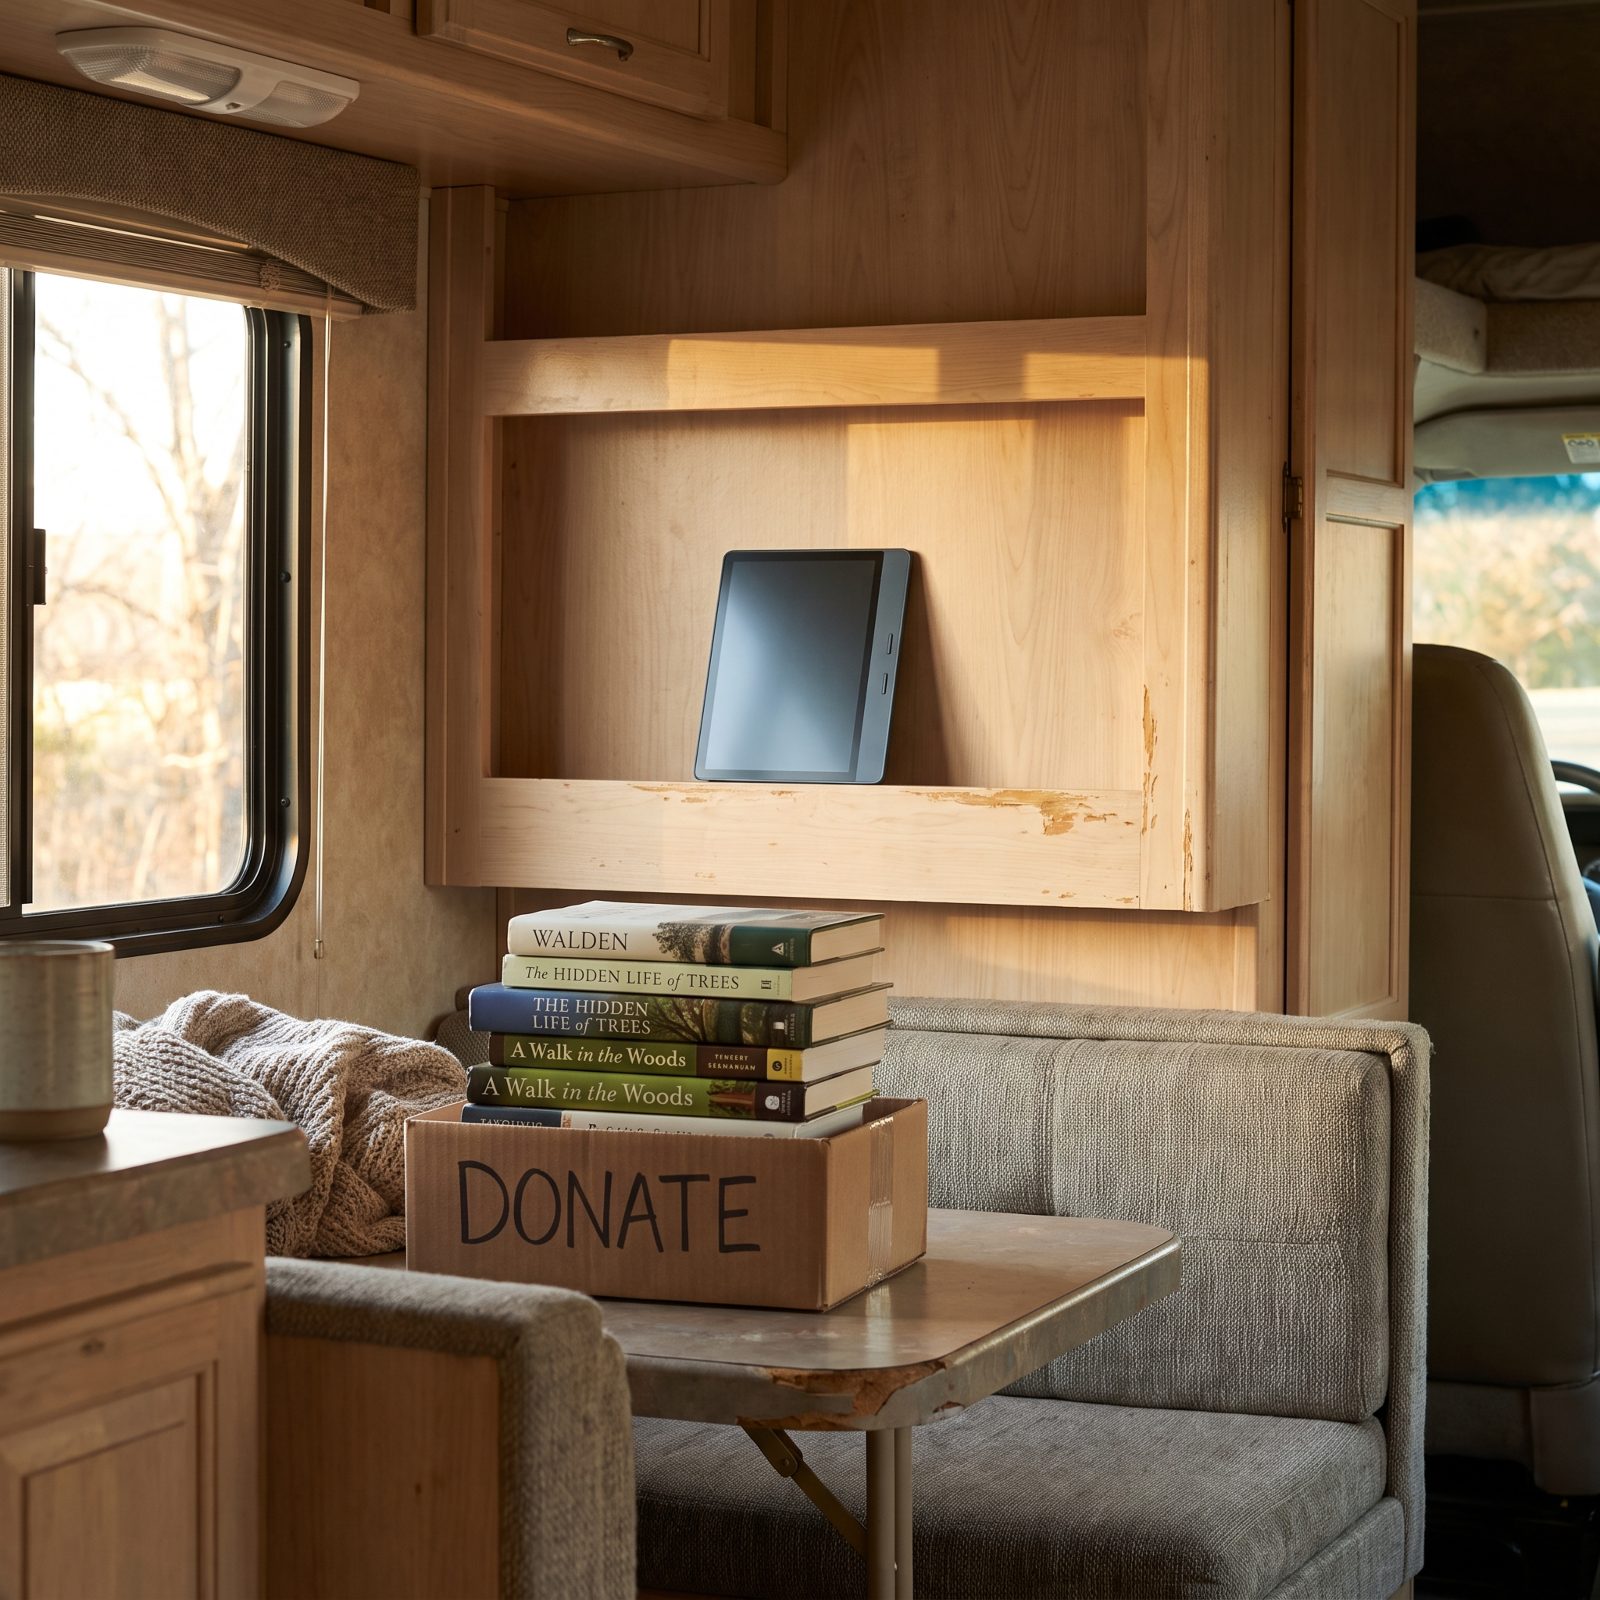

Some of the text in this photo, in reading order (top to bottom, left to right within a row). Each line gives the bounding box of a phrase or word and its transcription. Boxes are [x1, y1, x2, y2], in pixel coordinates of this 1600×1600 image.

[533, 929, 628, 951] WALDEN
[525, 966, 739, 991] The HIDDEN LIFE of TREES
[534, 997, 649, 1016] THE HIDDEN
[533, 1015, 651, 1035] LIFE of TREES
[510, 1041, 686, 1067] A Walk in the Woods
[482, 1076, 693, 1106] A Walk in the Woods
[458, 1160, 761, 1253] DONATE
